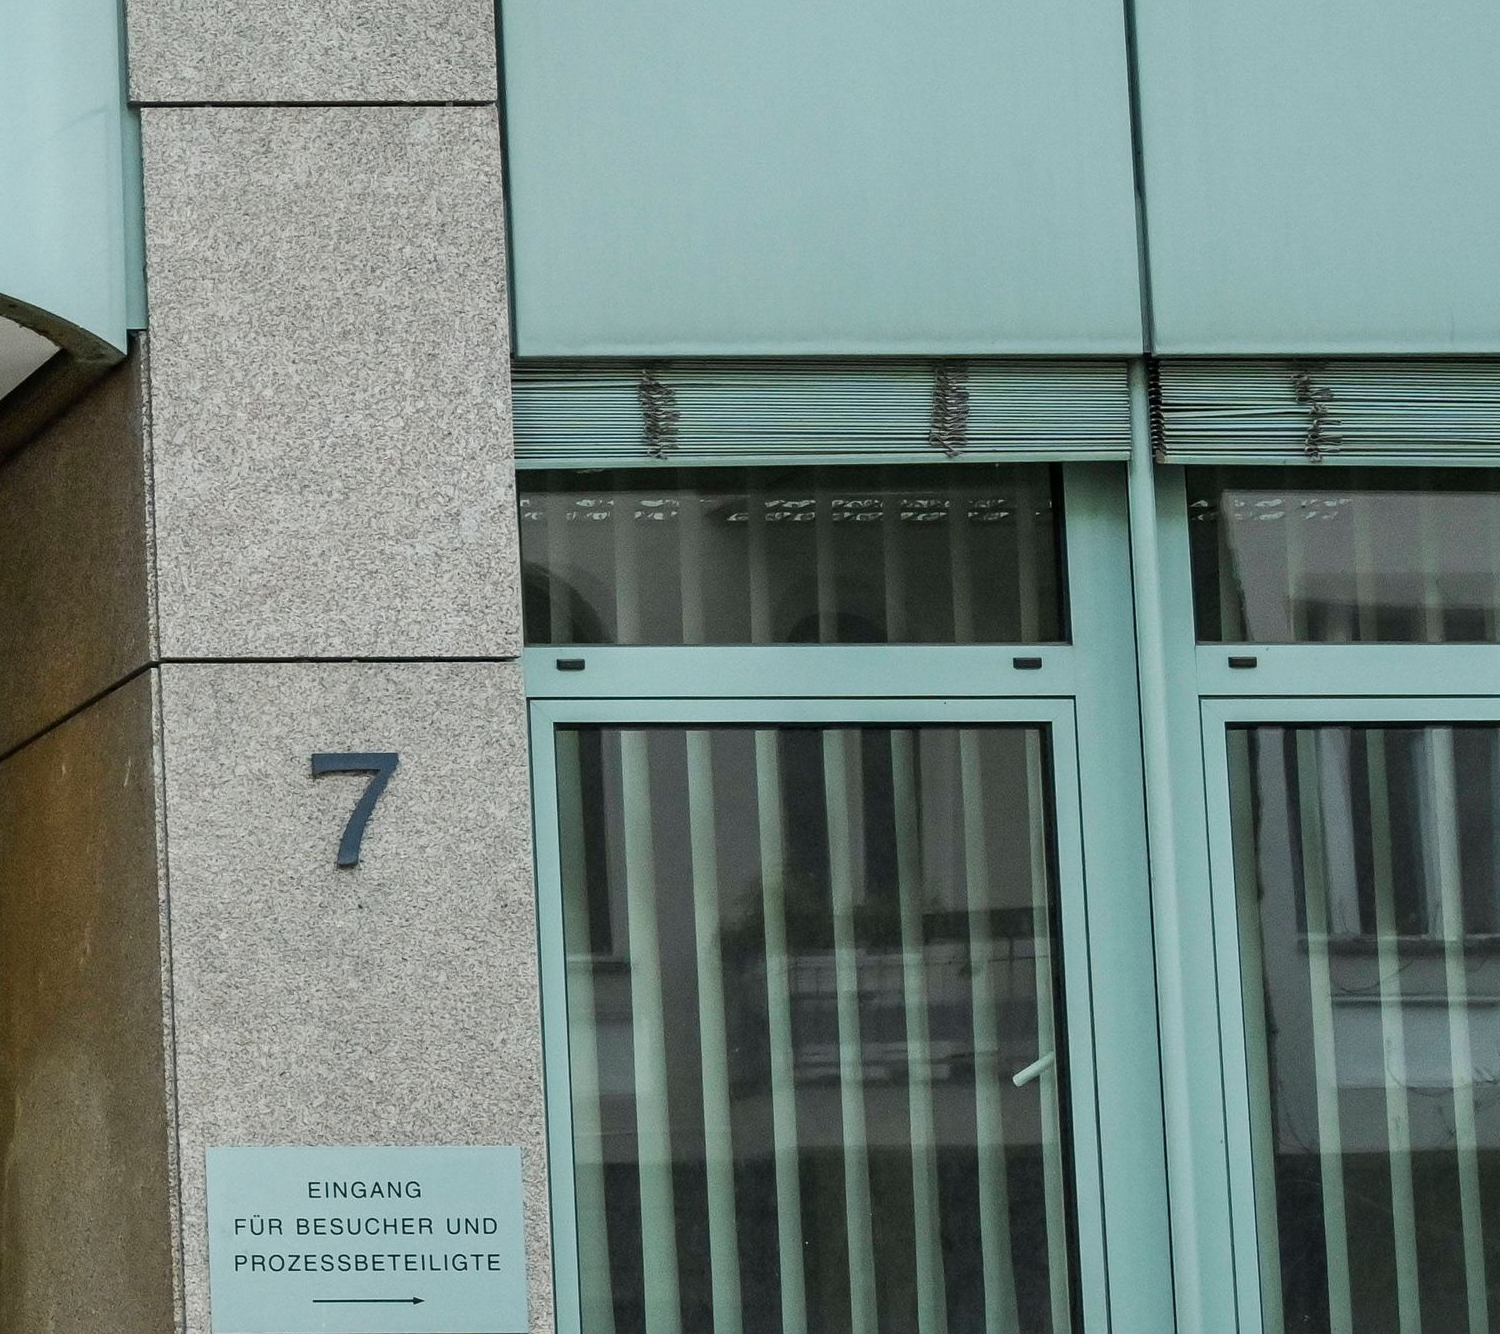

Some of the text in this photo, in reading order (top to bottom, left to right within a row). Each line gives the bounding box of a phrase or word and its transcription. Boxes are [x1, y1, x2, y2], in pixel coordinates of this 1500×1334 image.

[311, 753, 399, 869] 7
[308, 1181, 422, 1199] EINGANG
[234, 1215, 498, 1236] FÜR BESUCHER UND
[234, 1254, 501, 1272] PROZESSBETEILIGTE
